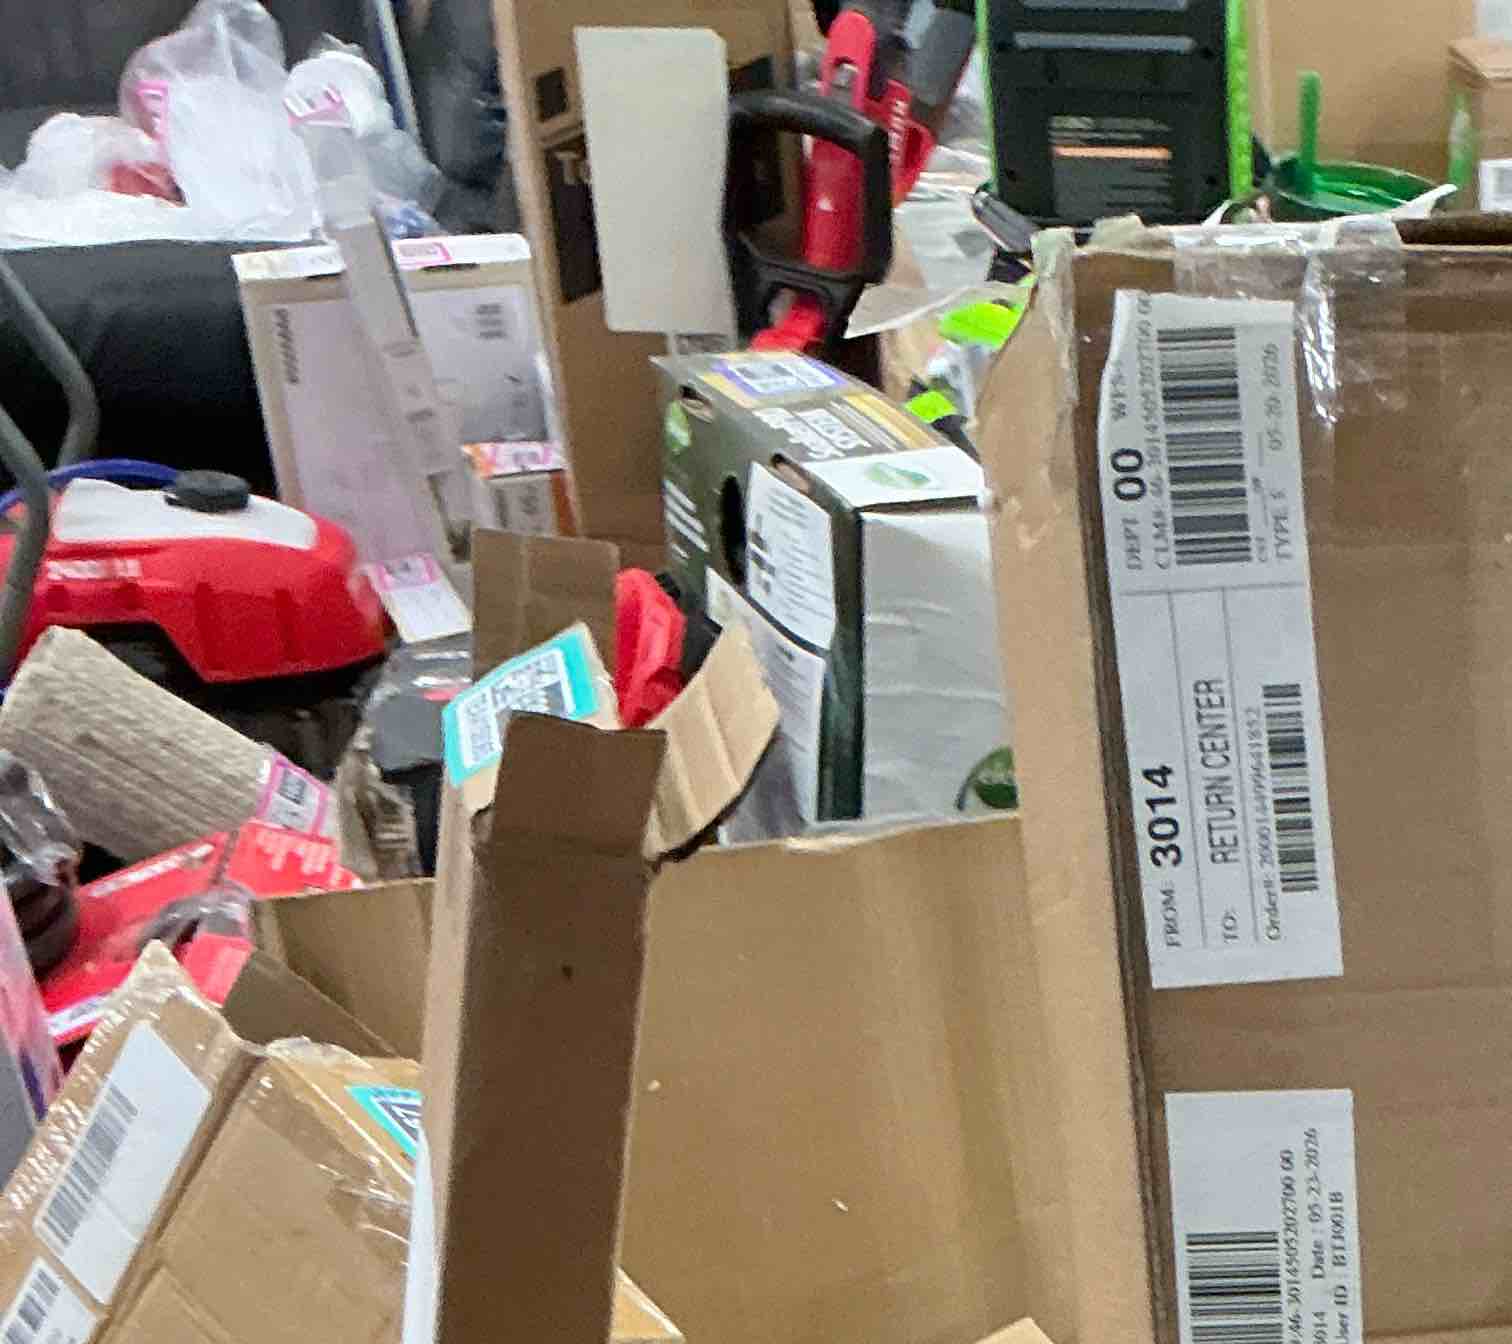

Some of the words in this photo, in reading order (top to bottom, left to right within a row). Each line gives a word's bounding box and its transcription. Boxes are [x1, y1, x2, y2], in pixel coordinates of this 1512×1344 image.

[1109, 445, 1147, 503] 00
[1191, 677, 1233, 770] CENTER
[1140, 763, 1184, 869] 3014
[1201, 773, 1242, 865] RETURN
[1308, 1237, 1326, 1279] Date
[1331, 1283, 1349, 1306] ID
